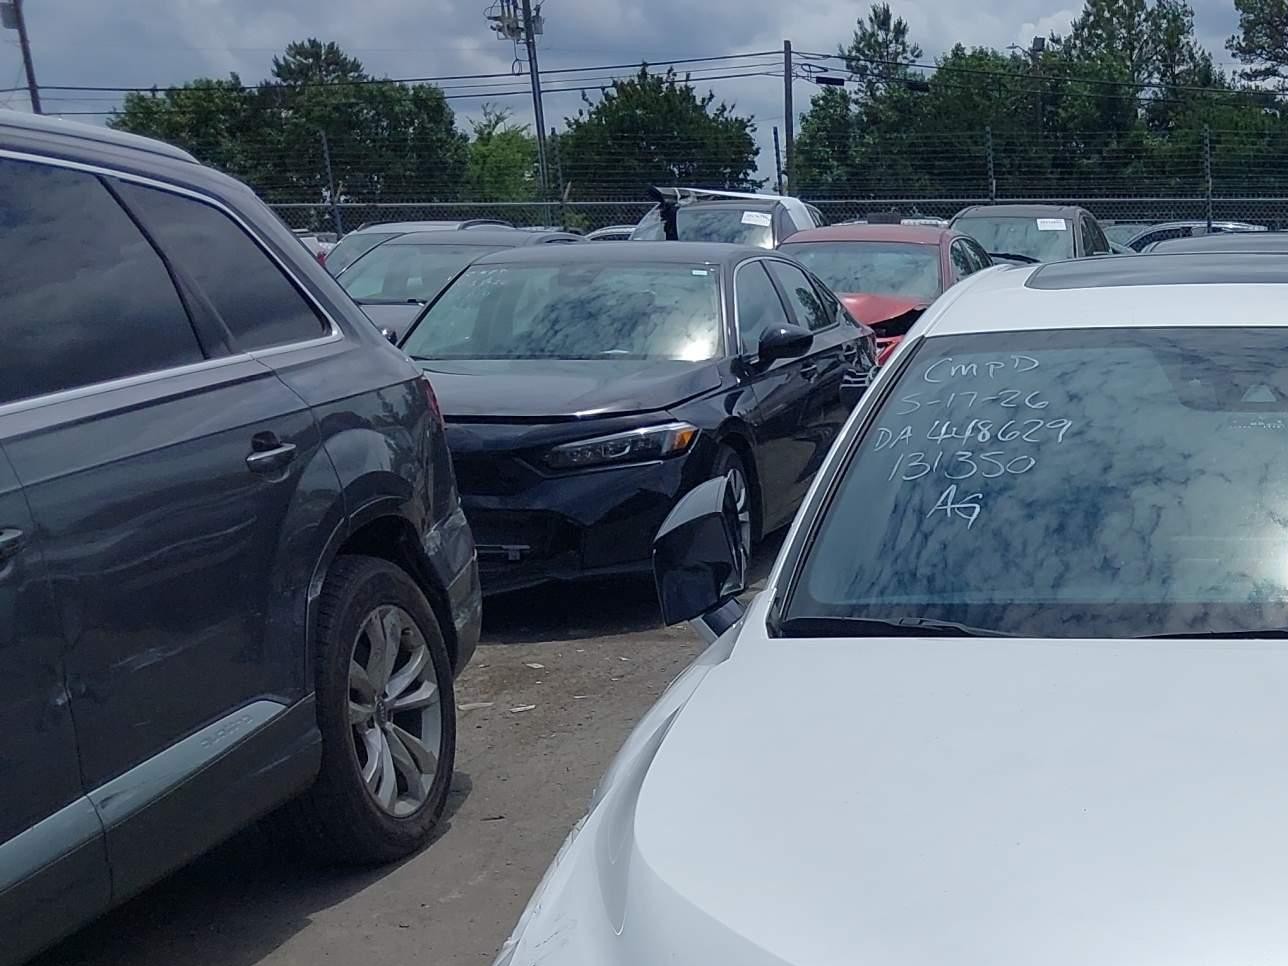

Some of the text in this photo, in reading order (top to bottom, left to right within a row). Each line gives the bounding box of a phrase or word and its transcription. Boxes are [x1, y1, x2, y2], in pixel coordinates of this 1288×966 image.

[896, 389, 1049, 415] 5-17-26
[874, 418, 1073, 451] DA 448629
[887, 451, 1037, 481] 131350
